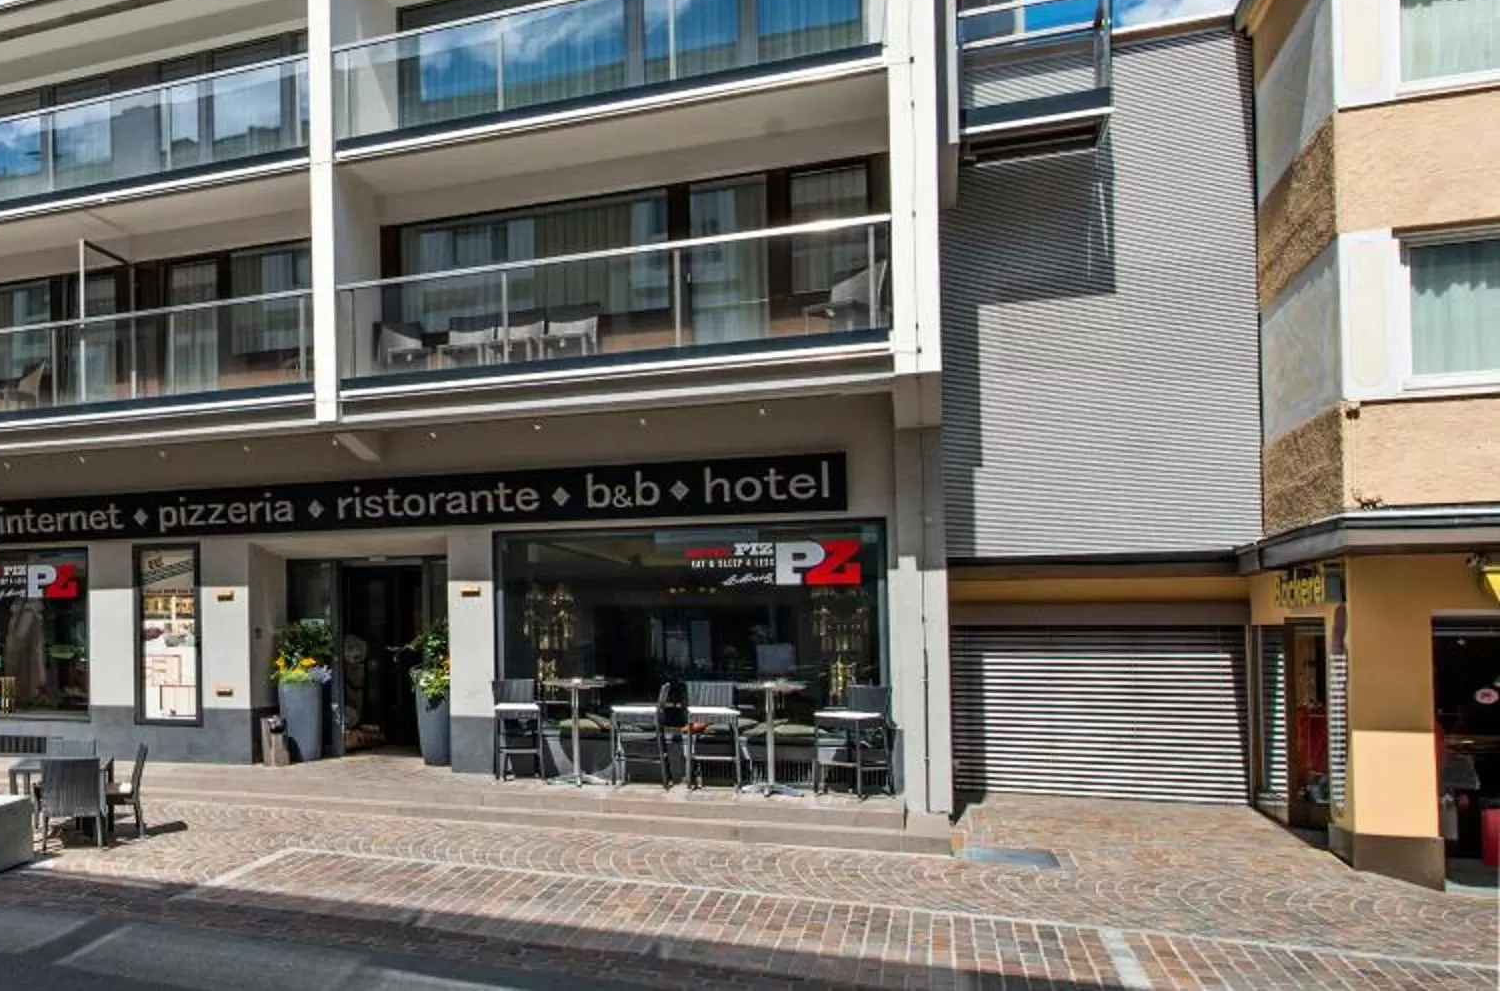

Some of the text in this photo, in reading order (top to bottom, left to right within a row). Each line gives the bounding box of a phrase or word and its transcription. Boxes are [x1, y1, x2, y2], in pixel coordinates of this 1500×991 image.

[159, 492, 294, 532] pizzeria
[337, 482, 540, 520] ristorante
[585, 470, 661, 509] b&b
[704, 460, 830, 504] hotel
[733, 542, 774, 556] PIZ
[775, 539, 862, 586] PZ
[28, 563, 80, 598] PZ
